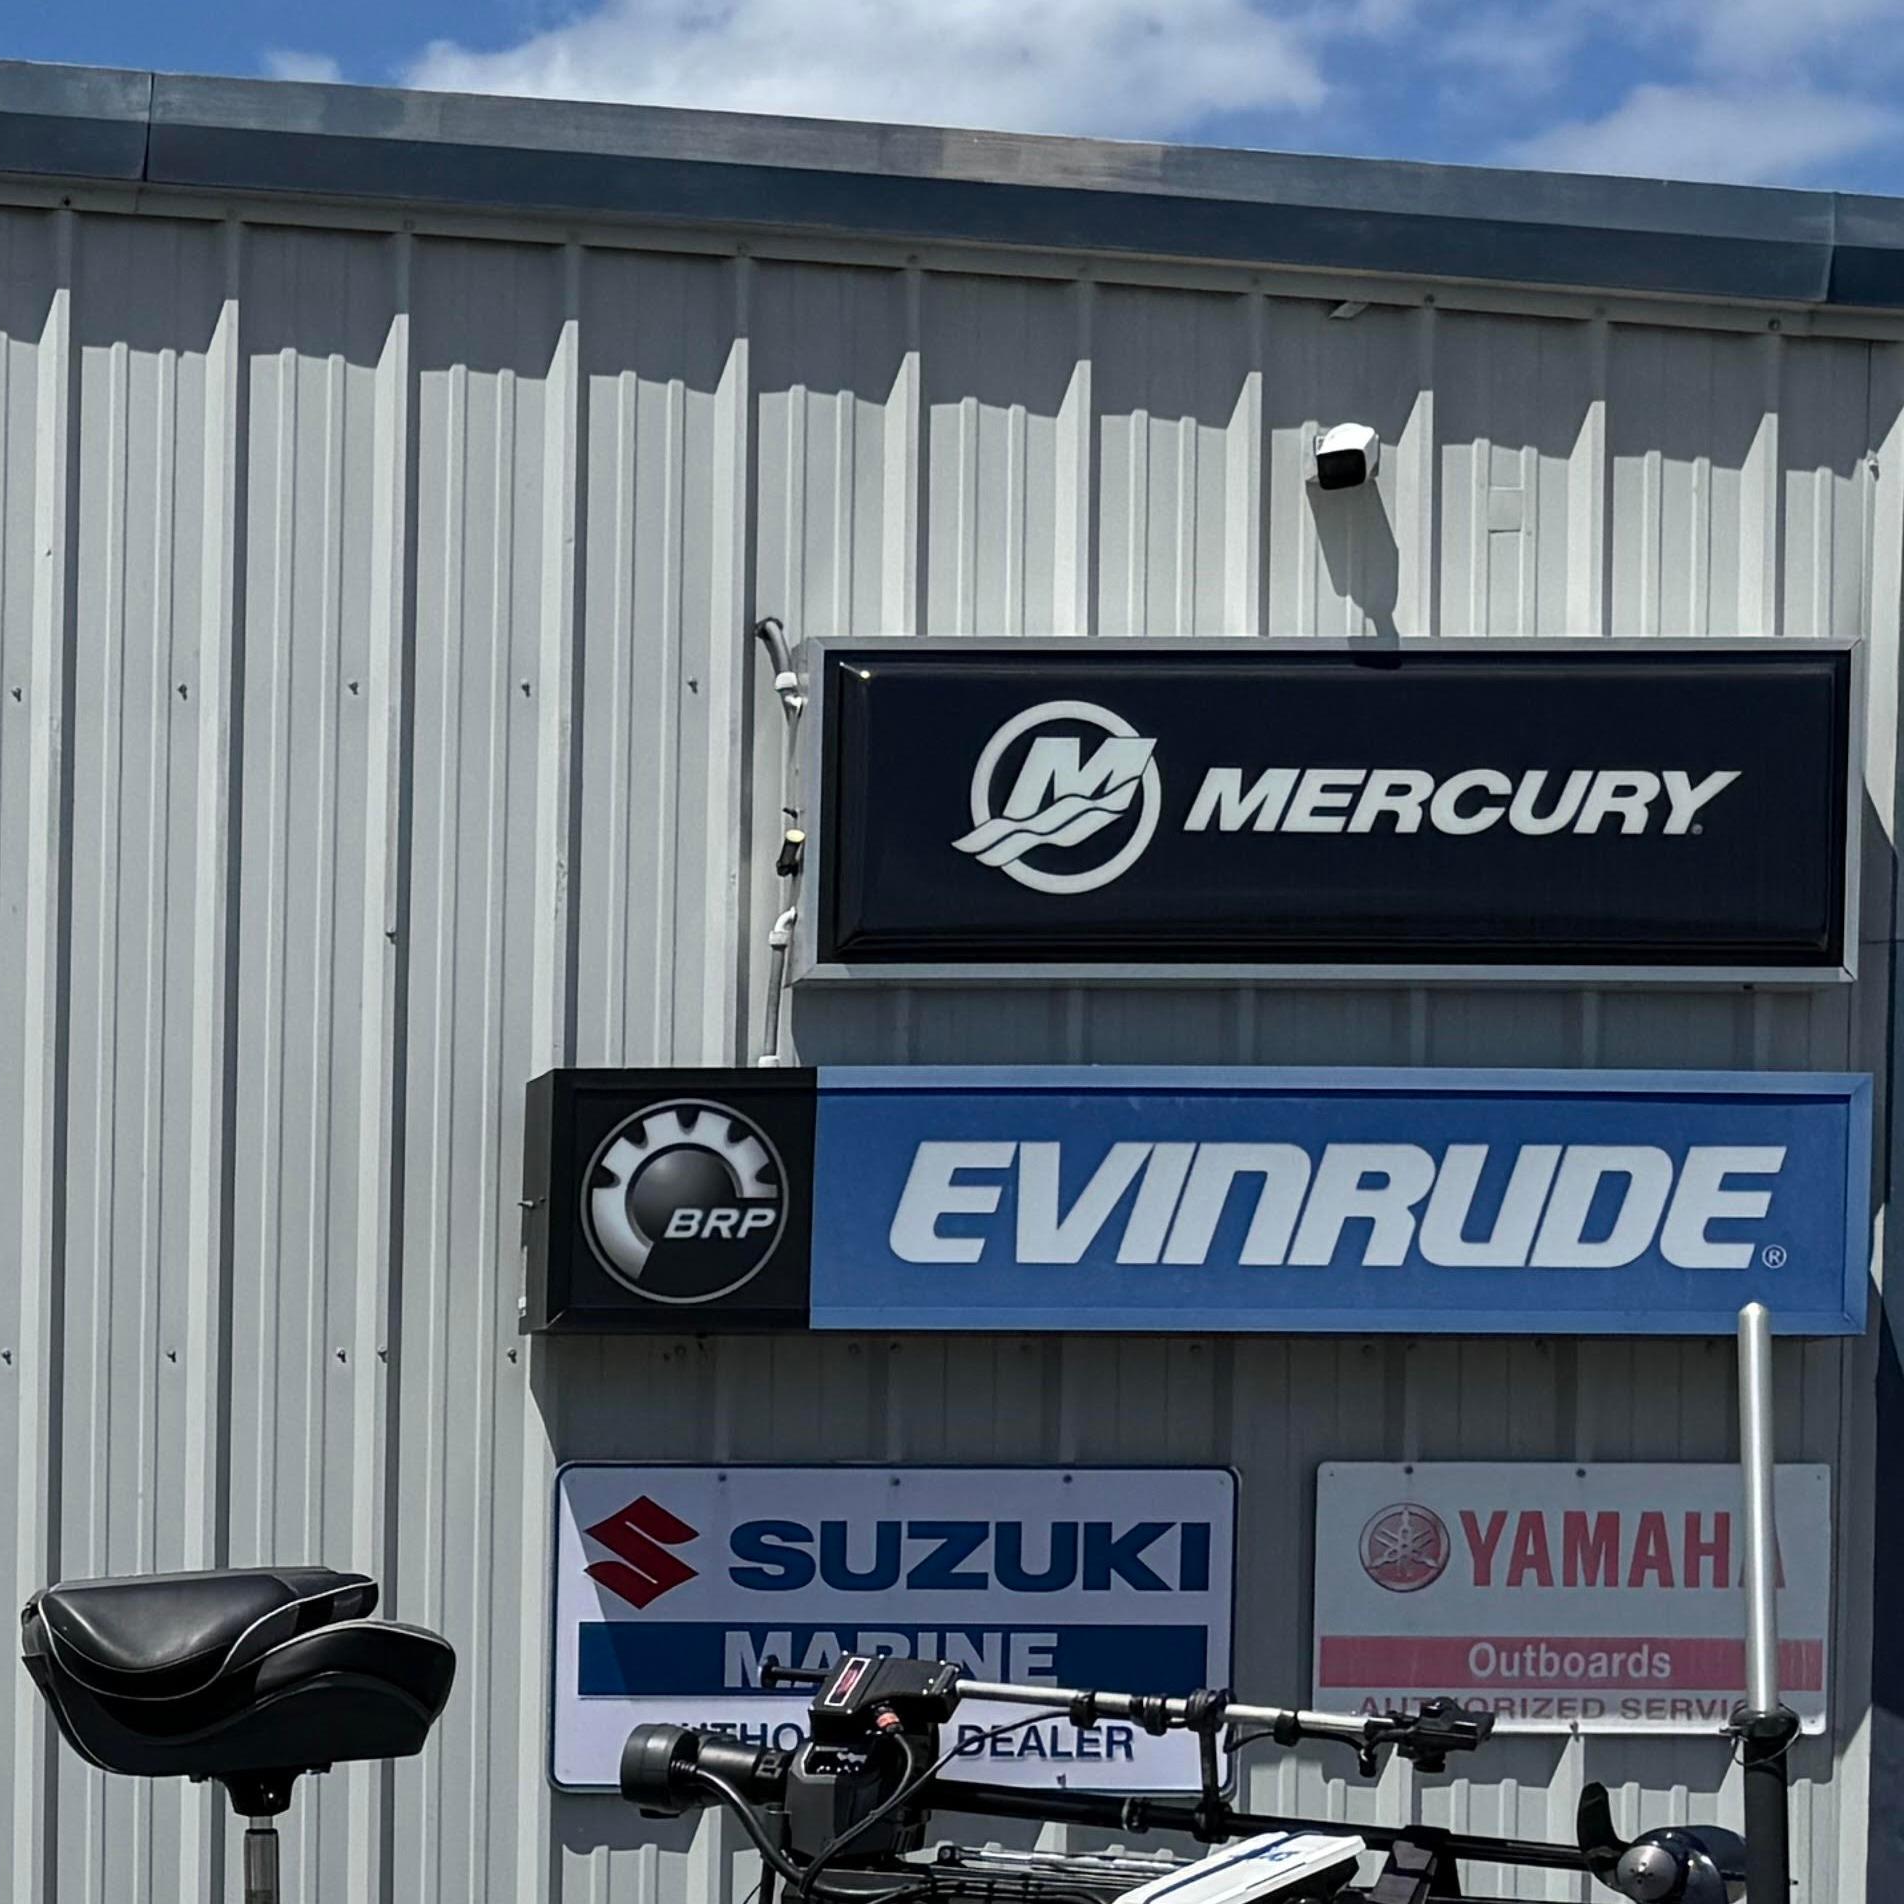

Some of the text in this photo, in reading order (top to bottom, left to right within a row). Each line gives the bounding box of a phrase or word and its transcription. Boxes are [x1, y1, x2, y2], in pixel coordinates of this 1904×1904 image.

[1184, 767, 1742, 835] MERCURY
[888, 1140, 1788, 1268] EVINRUDE
[663, 1206, 777, 1241] BRP
[728, 1520, 1210, 1594] SUZUKI
[1468, 1642, 1672, 1680] Outboards
[1360, 1697, 1605, 1720] AUTORIZED
[957, 1724, 1134, 1760] DEALER
